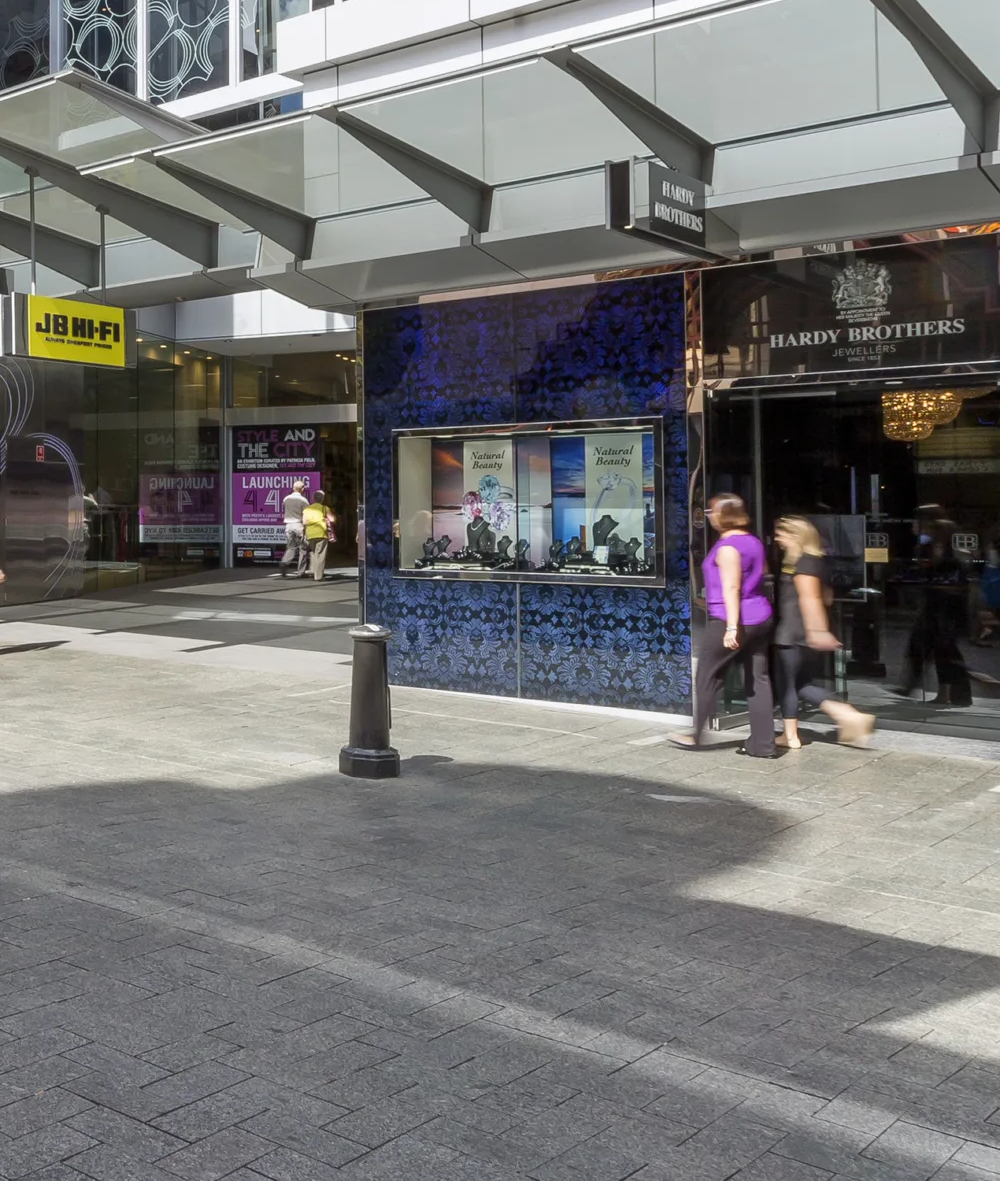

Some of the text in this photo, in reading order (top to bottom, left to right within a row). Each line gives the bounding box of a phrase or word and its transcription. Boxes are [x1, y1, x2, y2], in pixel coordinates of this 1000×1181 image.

[662, 180, 695, 206] HARDY
[654, 201, 703, 233] BROTHERS
[35, 313, 69, 336] JB
[769, 318, 966, 348] HARDY BROTHERS
[832, 344, 897, 357] JEWELLERS
[237, 428, 315, 443] STYLE AND
[237, 441, 315, 458] THE CITY
[470, 450, 505, 460] Natural
[592, 445, 635, 457] Natural
[472, 460, 504, 470] Beauty
[595, 456, 632, 468] Beauty
